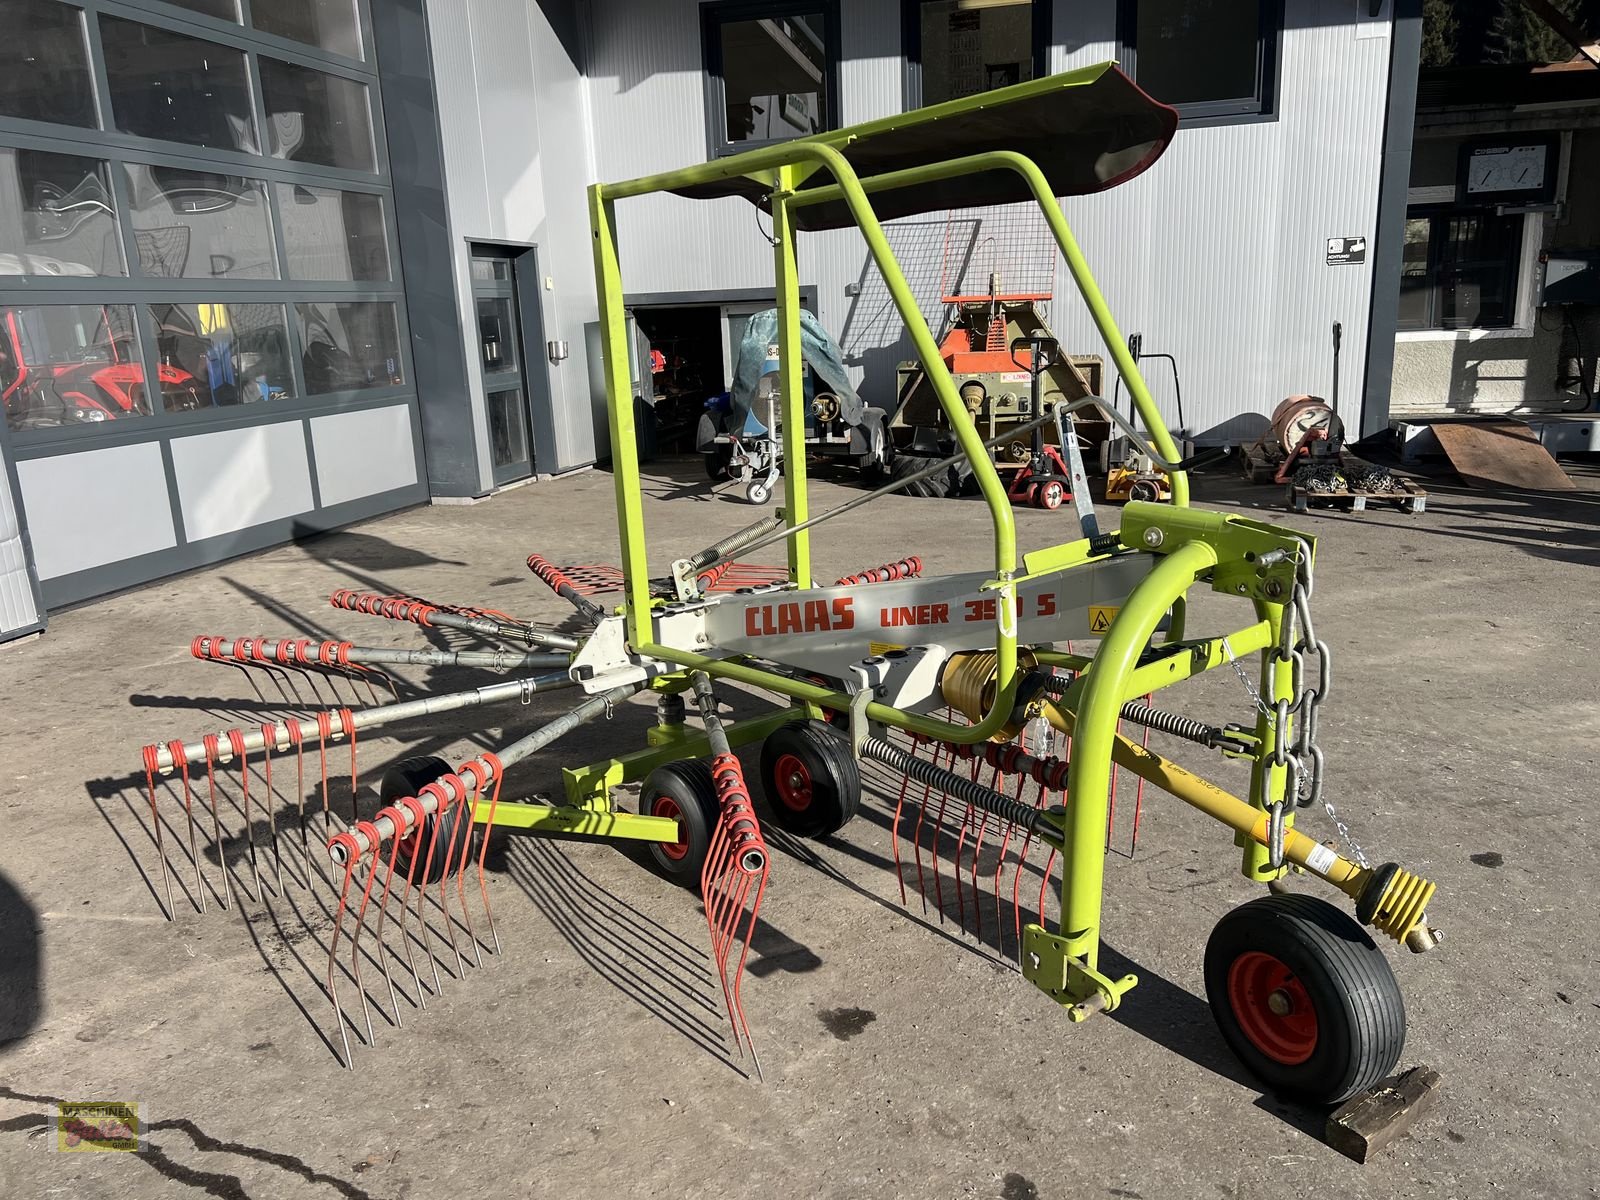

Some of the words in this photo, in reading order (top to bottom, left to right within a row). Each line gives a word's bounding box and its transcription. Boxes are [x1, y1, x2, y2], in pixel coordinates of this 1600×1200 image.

[745, 597, 855, 636] CLAAS
[880, 603, 949, 627] LINER
[1037, 593, 1056, 616] S
